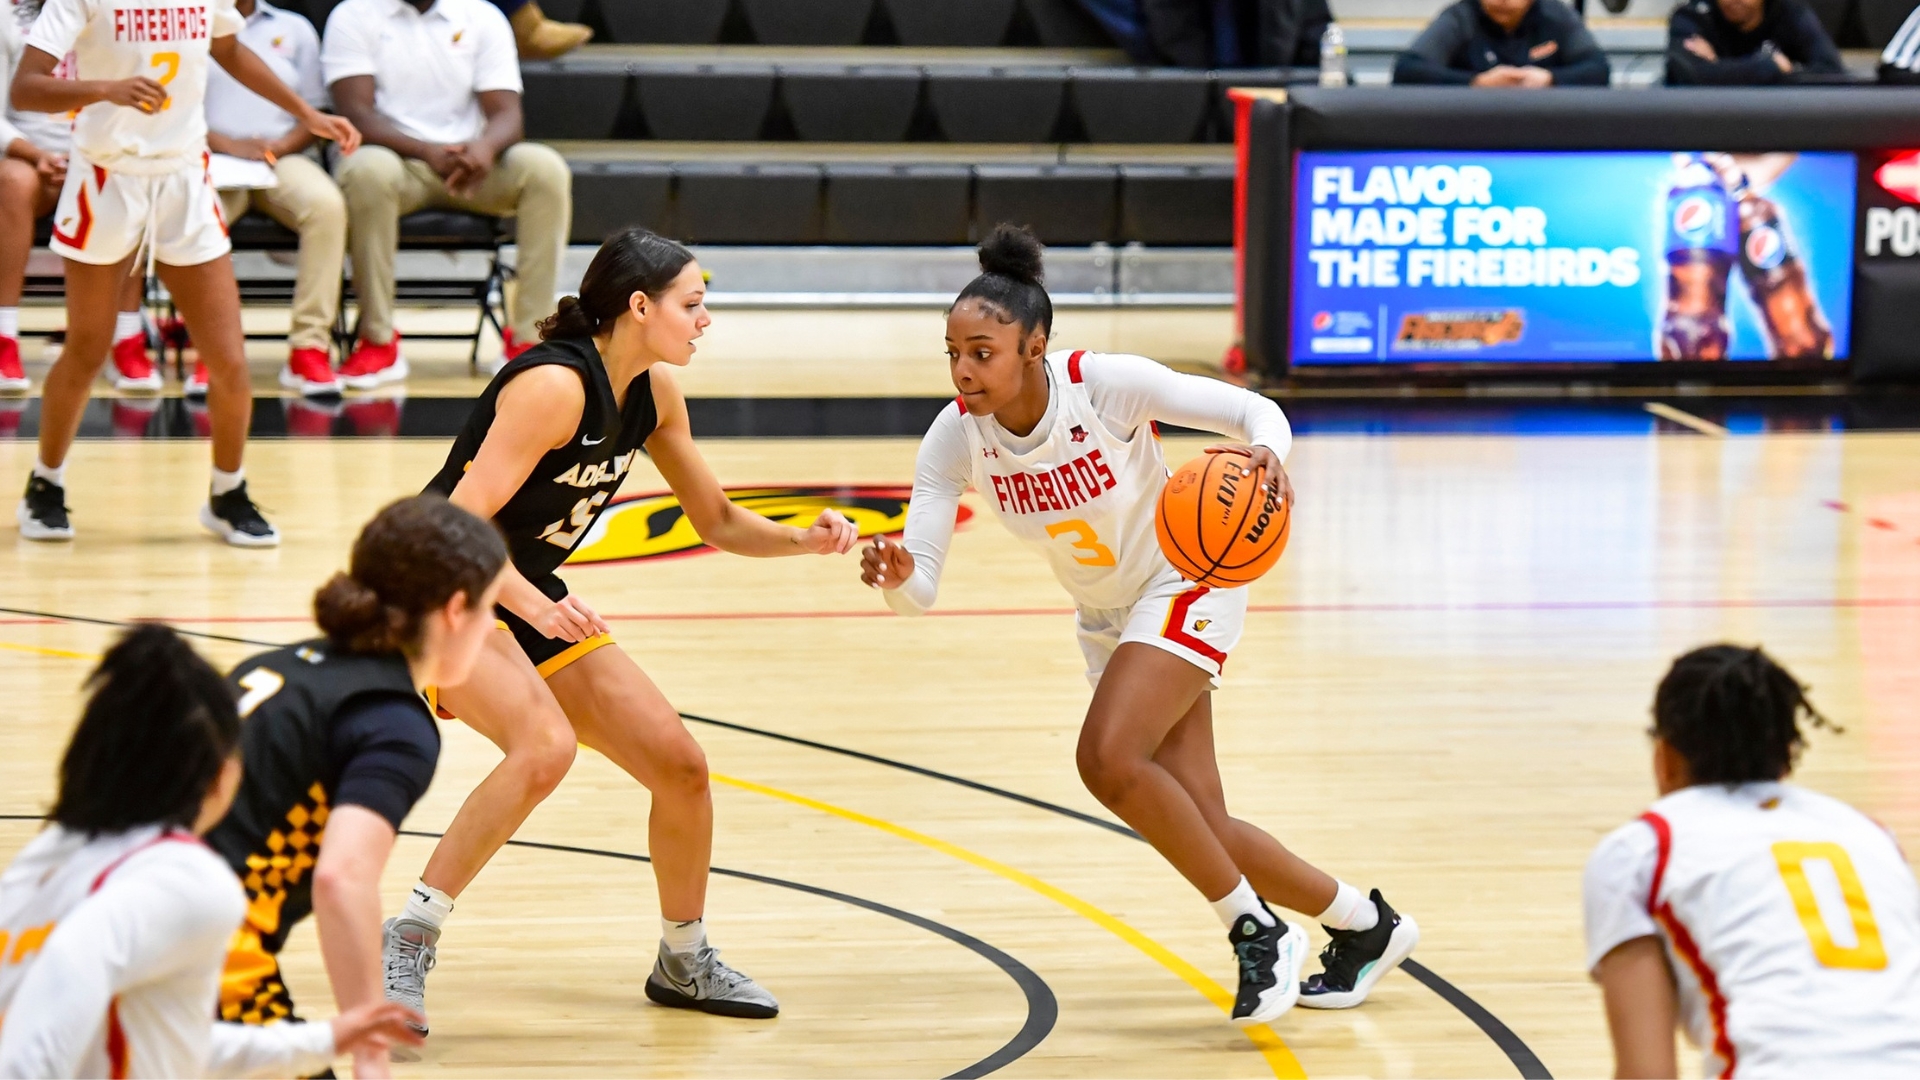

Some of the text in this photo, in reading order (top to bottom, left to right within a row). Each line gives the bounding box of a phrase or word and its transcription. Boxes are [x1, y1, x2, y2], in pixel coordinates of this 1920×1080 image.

[114, 7, 206, 42] FIREBIRDS
[1312, 165, 1492, 205] FLAVOR
[1311, 206, 1548, 246] MADE FOR
[1865, 206, 1920, 257] PO
[1308, 246, 1641, 288] THE FIREBIRDS
[990, 448, 1117, 515] FIREBIRDS
[1044, 518, 1117, 567] 3
[1770, 841, 1888, 970] 0
